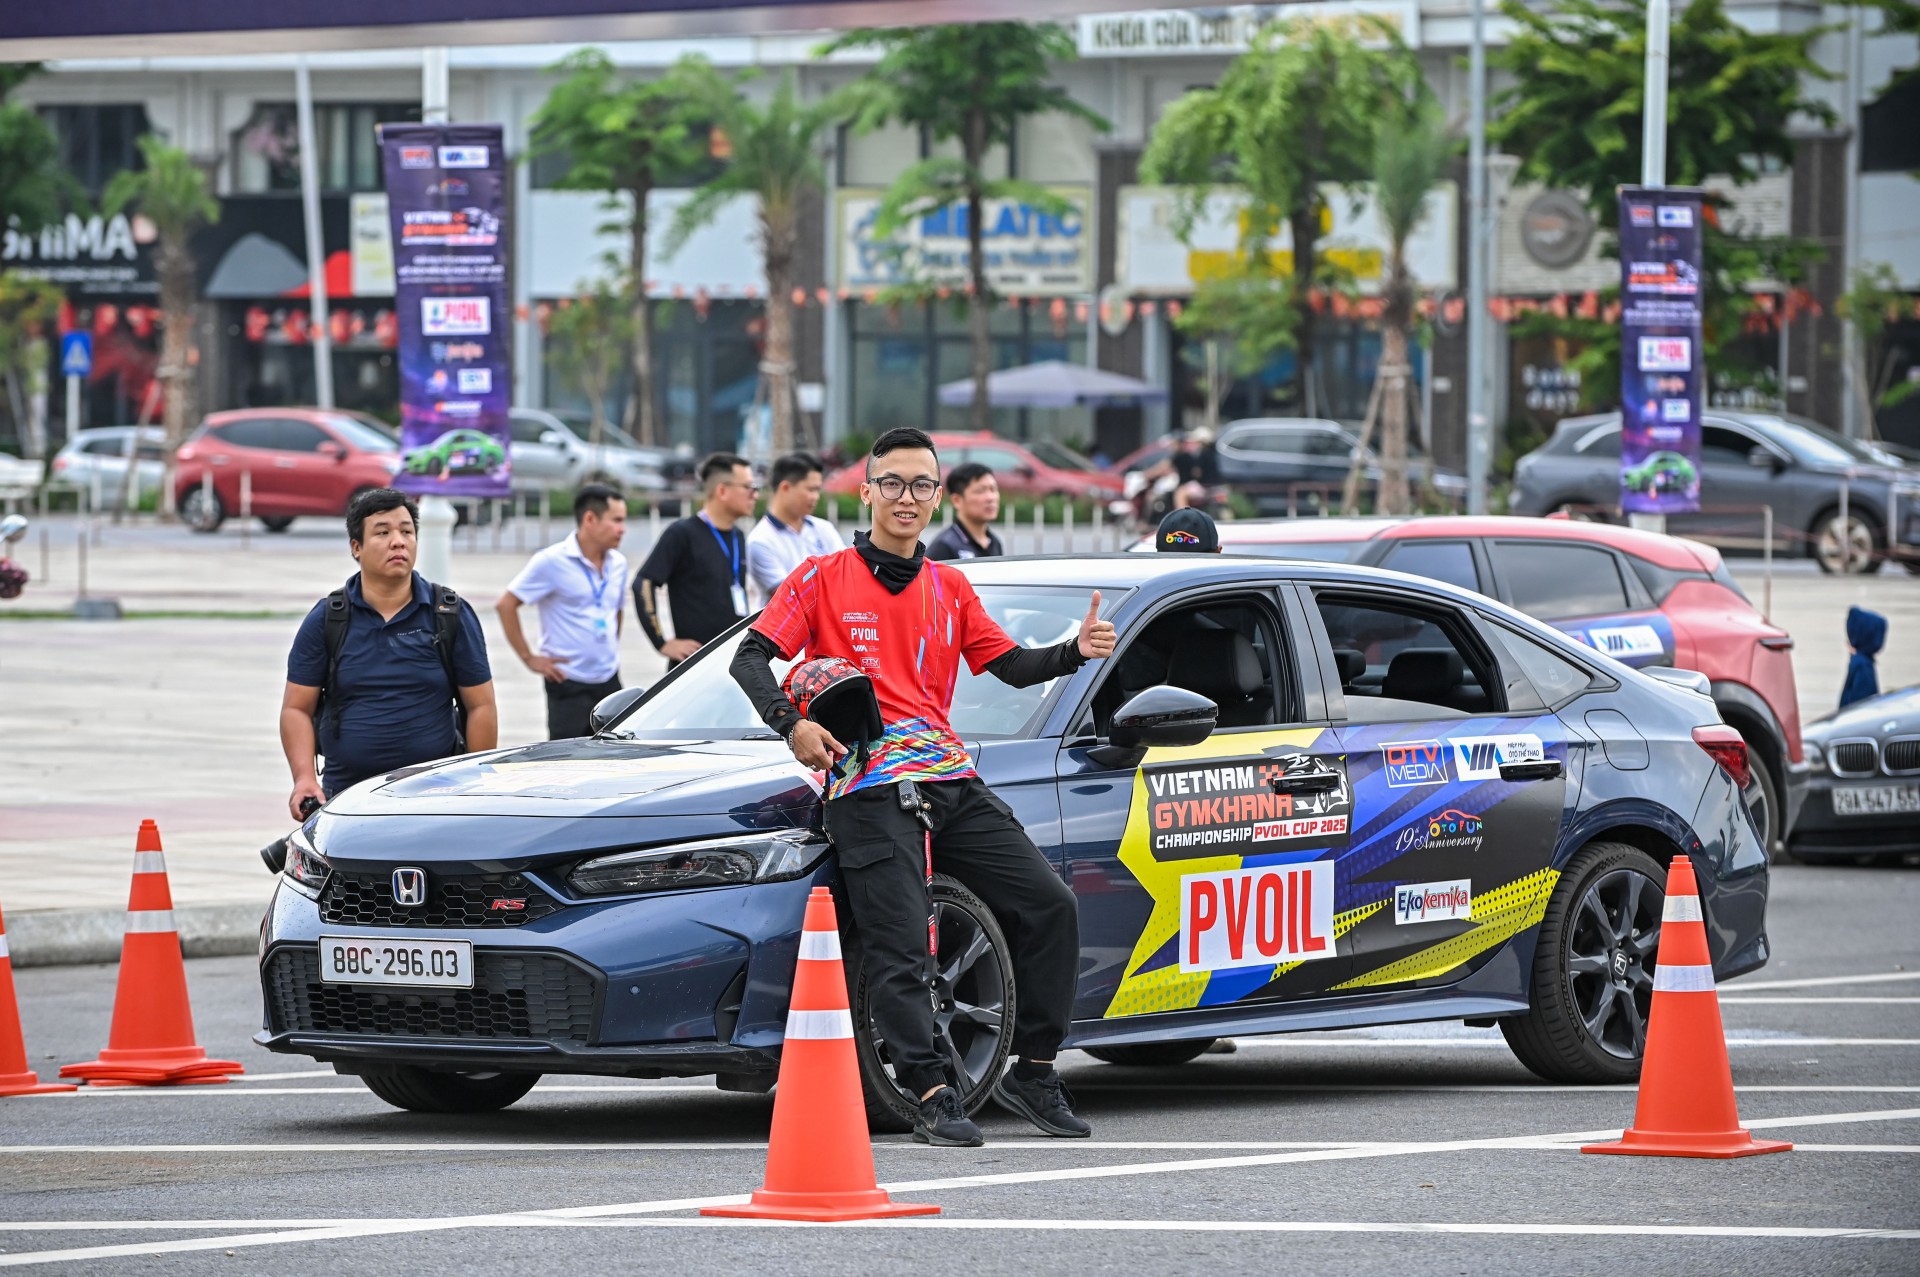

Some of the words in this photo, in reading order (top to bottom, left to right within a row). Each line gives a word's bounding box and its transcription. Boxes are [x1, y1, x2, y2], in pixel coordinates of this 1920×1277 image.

[1165, 535, 1200, 544] OTOFUN
[850, 627, 880, 641] PVOIL
[1387, 744, 1439, 766] OTV
[1527, 749, 1540, 757] THAO
[1150, 765, 1255, 797] VIETNAM
[1389, 763, 1446, 782] MEDIA
[1154, 793, 1293, 829] GYMKHANA
[1155, 826, 1253, 849] CHAMPIONSHIP
[1254, 824, 1290, 840] PVOIL
[1292, 822, 1318, 835] CUP
[1321, 818, 1346, 833] 2025
[1429, 822, 1483, 837] OTOFUN
[1414, 831, 1484, 852] Anniversary
[490, 898, 526, 911] RS
[1397, 885, 1469, 921] Ekokemika
[1189, 869, 1326, 965] PVOIL
